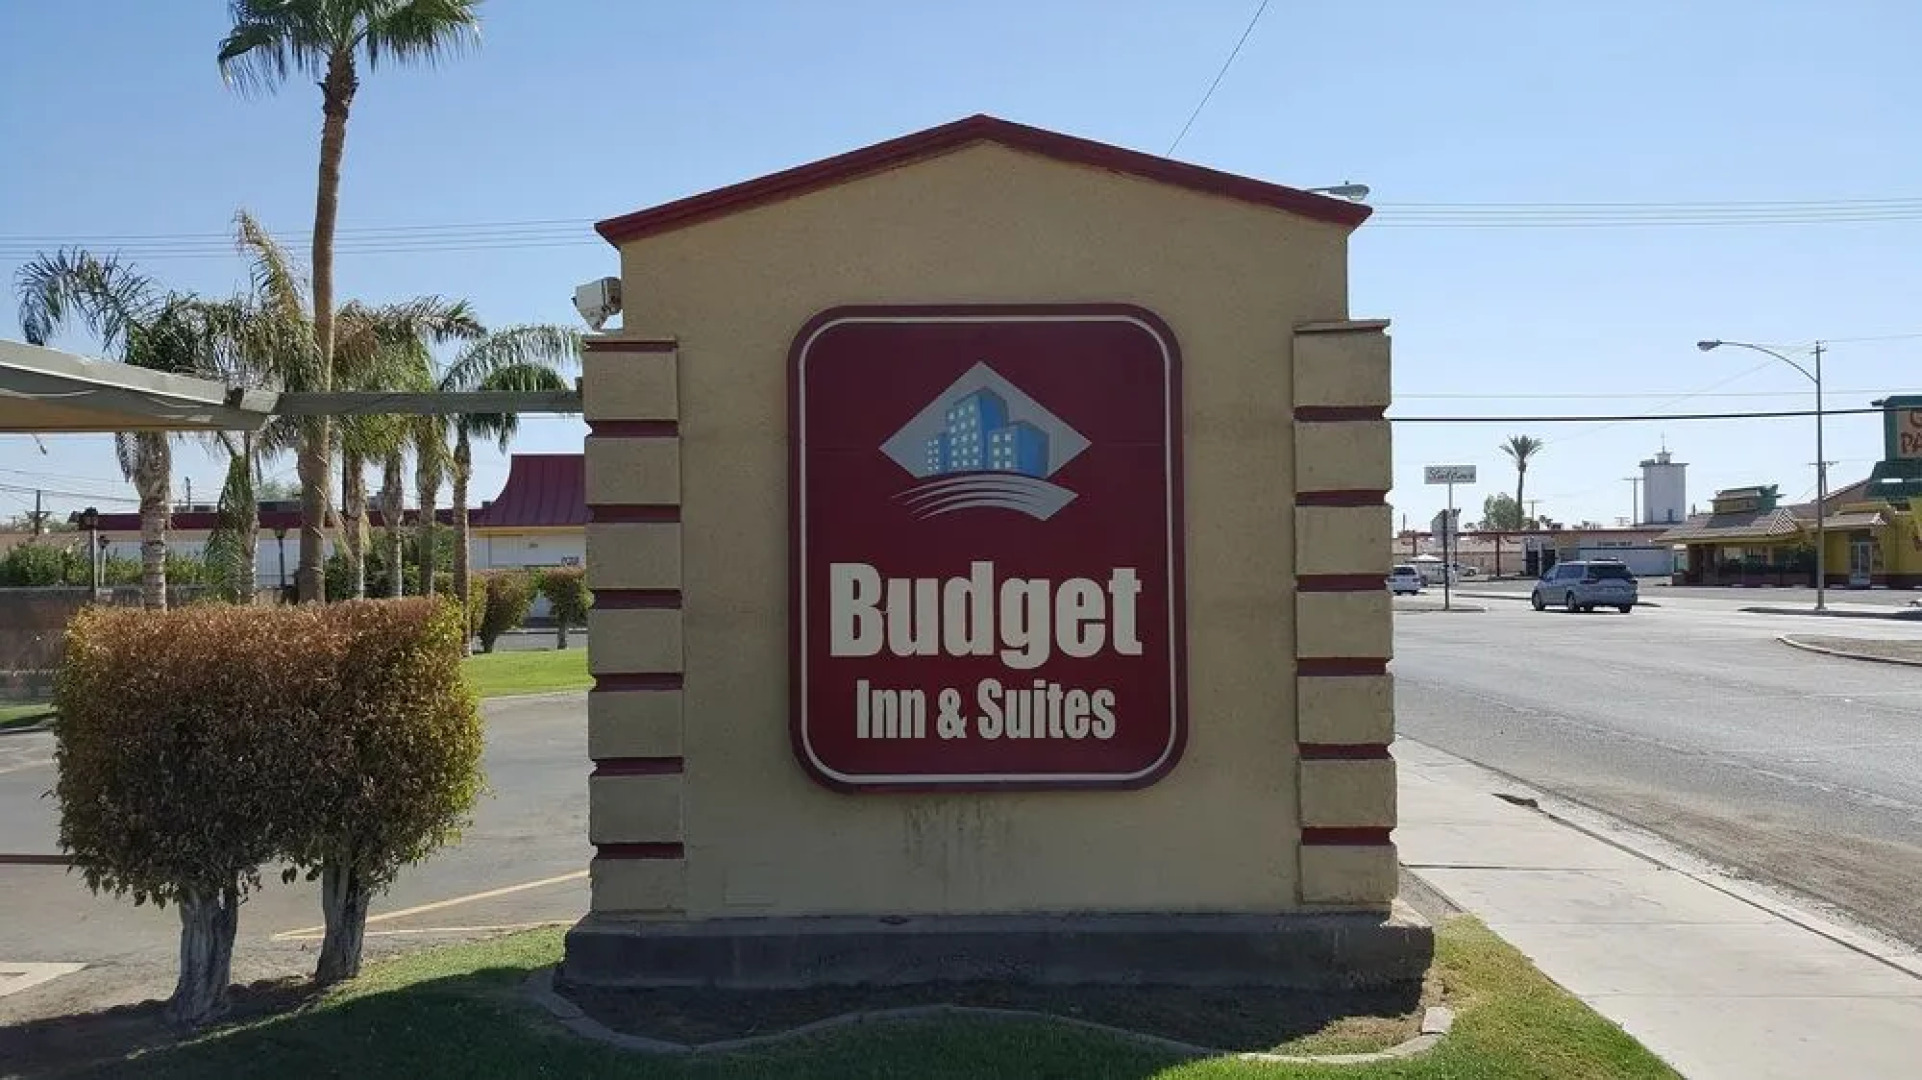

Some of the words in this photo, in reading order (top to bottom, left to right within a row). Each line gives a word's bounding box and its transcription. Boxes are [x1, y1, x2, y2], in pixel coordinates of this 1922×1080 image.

[829, 560, 1143, 669] Budget
[856, 679, 926, 739] Inn
[937, 687, 967, 740] &
[977, 678, 1117, 740] Suites
